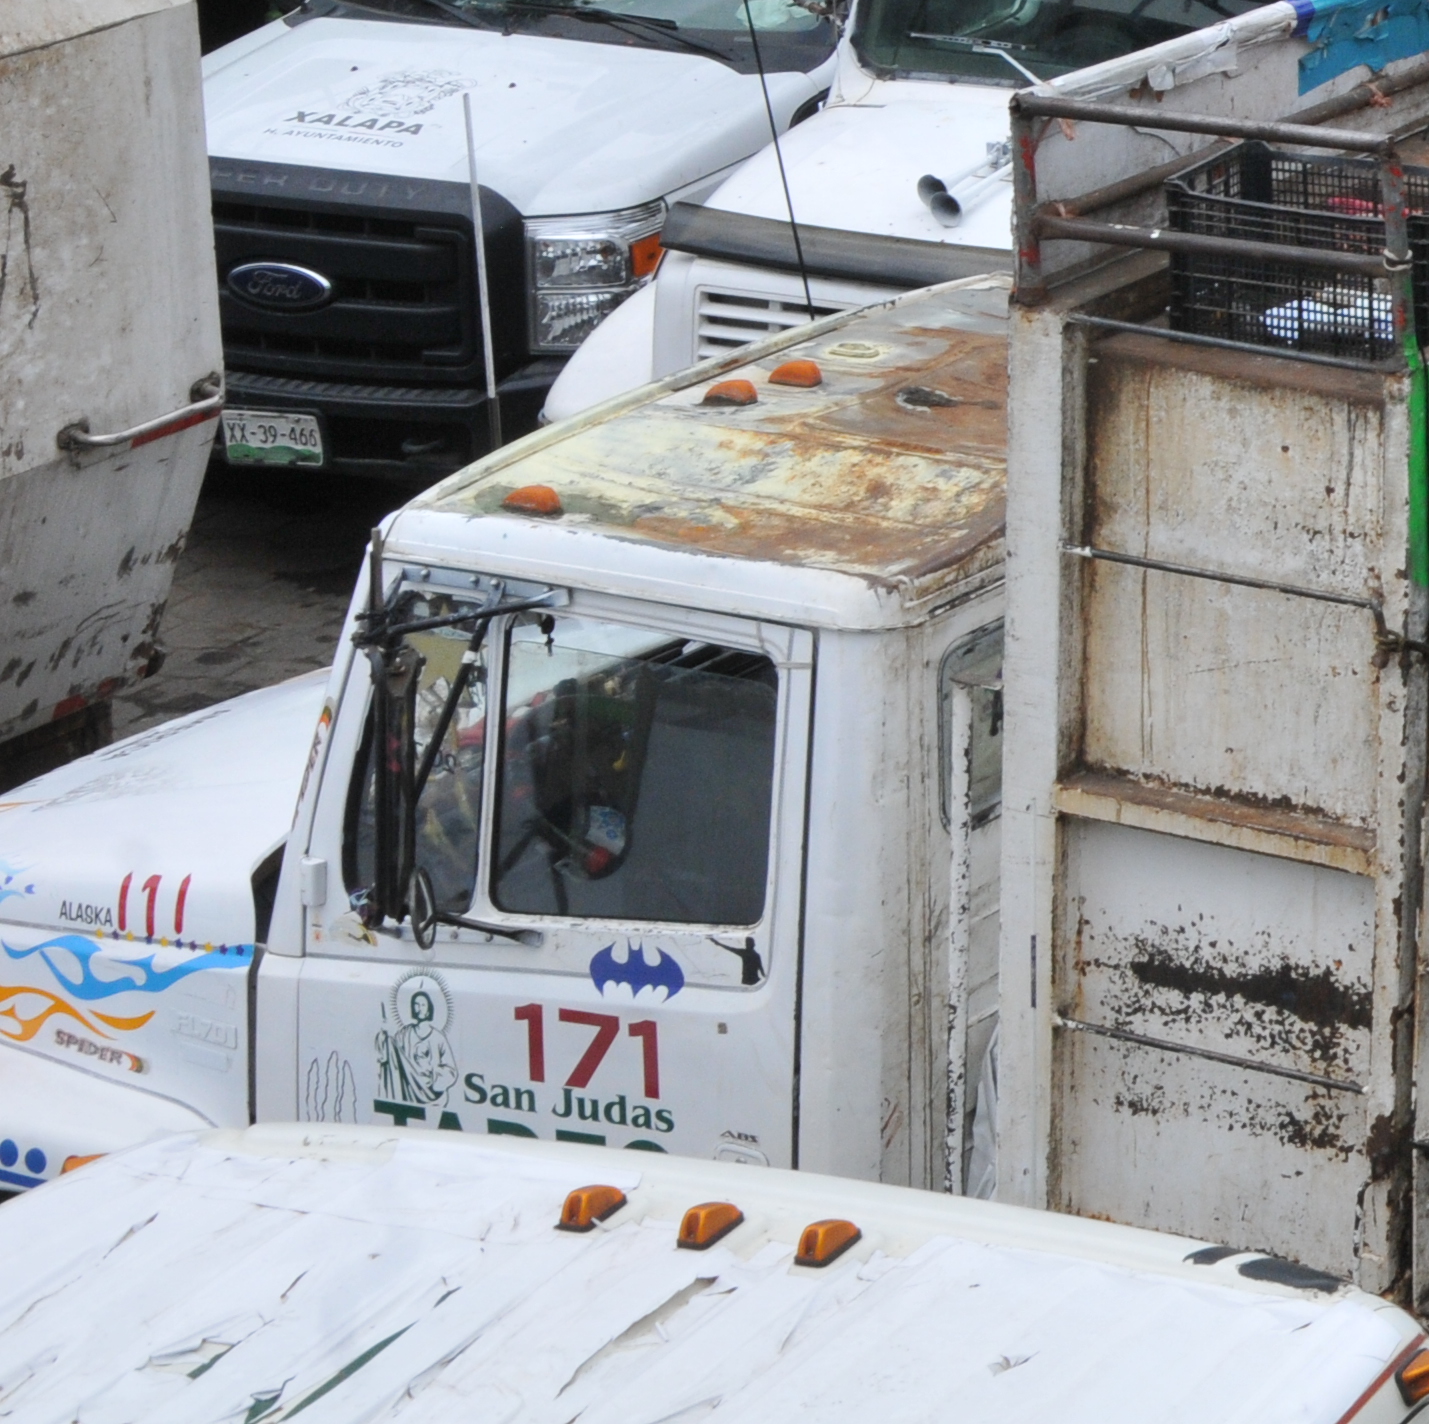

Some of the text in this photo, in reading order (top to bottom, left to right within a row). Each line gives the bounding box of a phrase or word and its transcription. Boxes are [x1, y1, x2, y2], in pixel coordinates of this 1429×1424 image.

[263, 127, 405, 149] H. AYUNTAMIENTO
[284, 111, 424, 136] XALAPA
[246, 270, 301, 300] Ford
[227, 422, 318, 448] XX-39-466
[59, 899, 113, 927] ALASKA
[55, 1028, 123, 1066] SPIDER
[514, 1003, 660, 1100] 171
[463, 1072, 538, 1115] San
[551, 1087, 676, 1133] Judas
